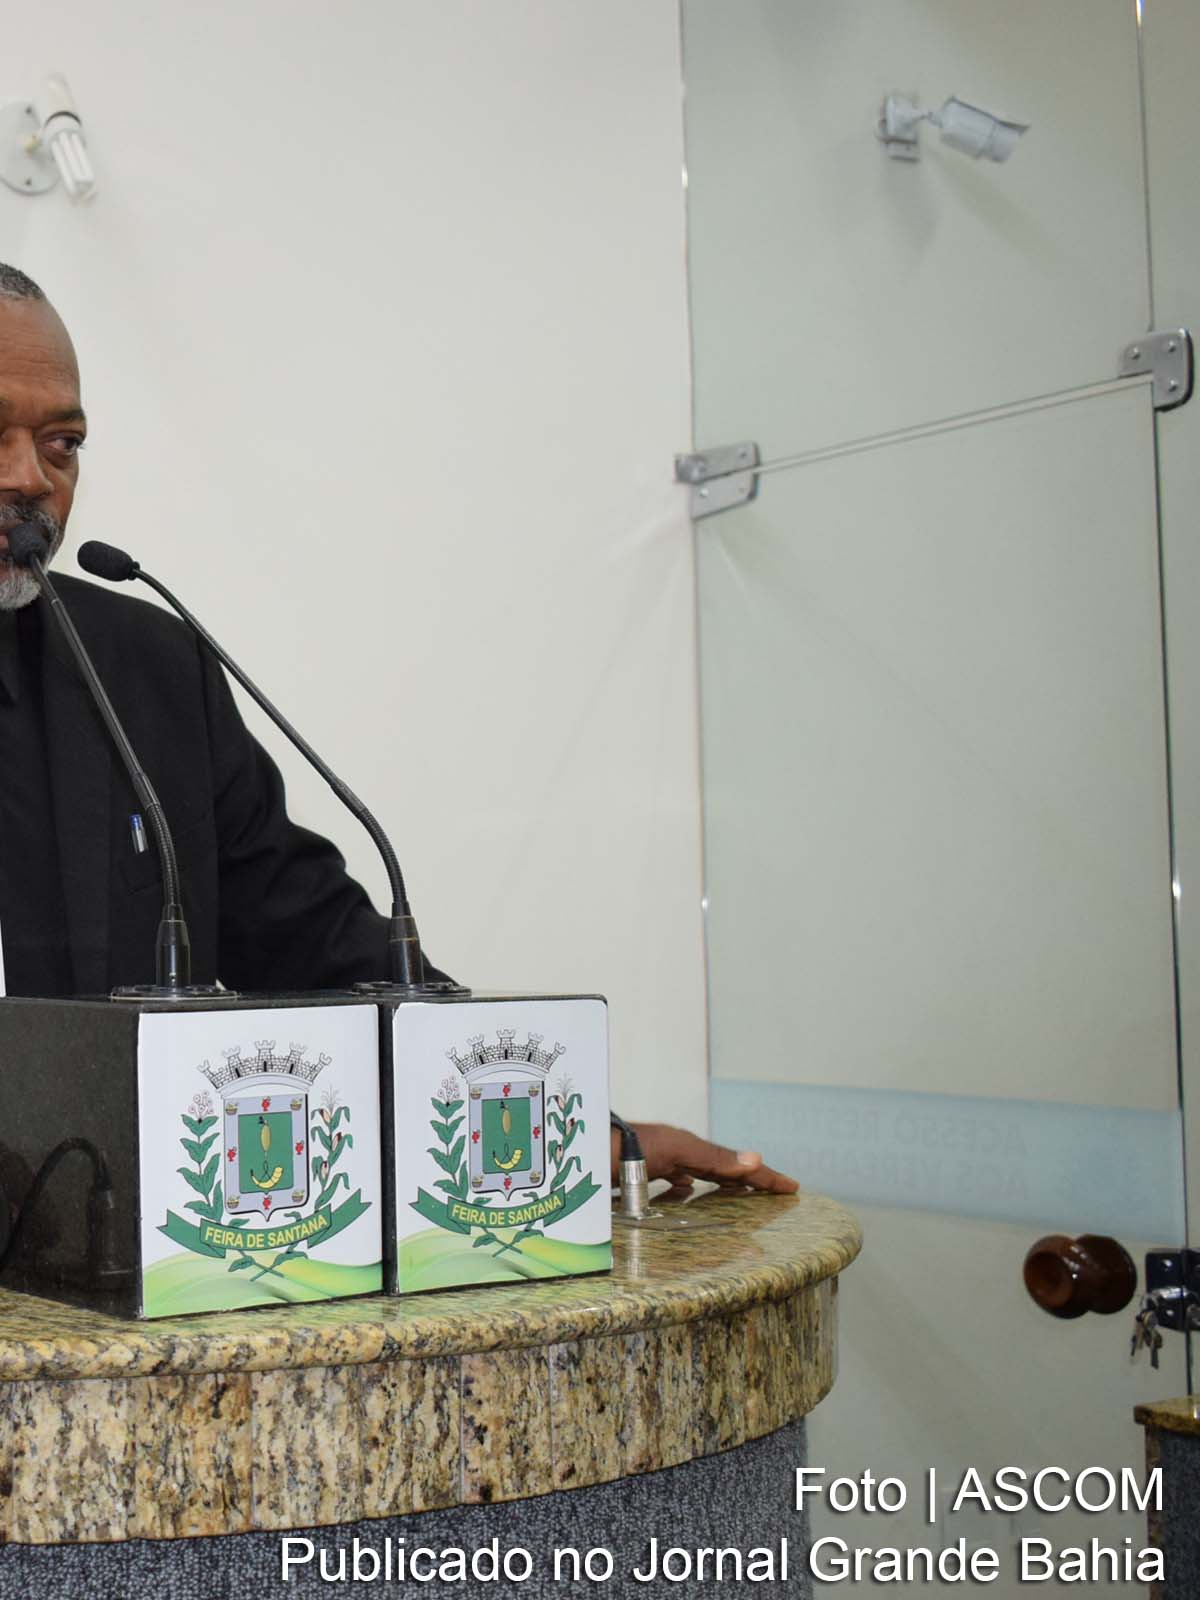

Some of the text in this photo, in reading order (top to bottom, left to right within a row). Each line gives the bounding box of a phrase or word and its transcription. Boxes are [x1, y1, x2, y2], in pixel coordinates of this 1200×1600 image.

[452, 1195, 562, 1225] FEIRA DE SANTANA
[205, 1214, 328, 1248] FEIRA DE SANTANA
